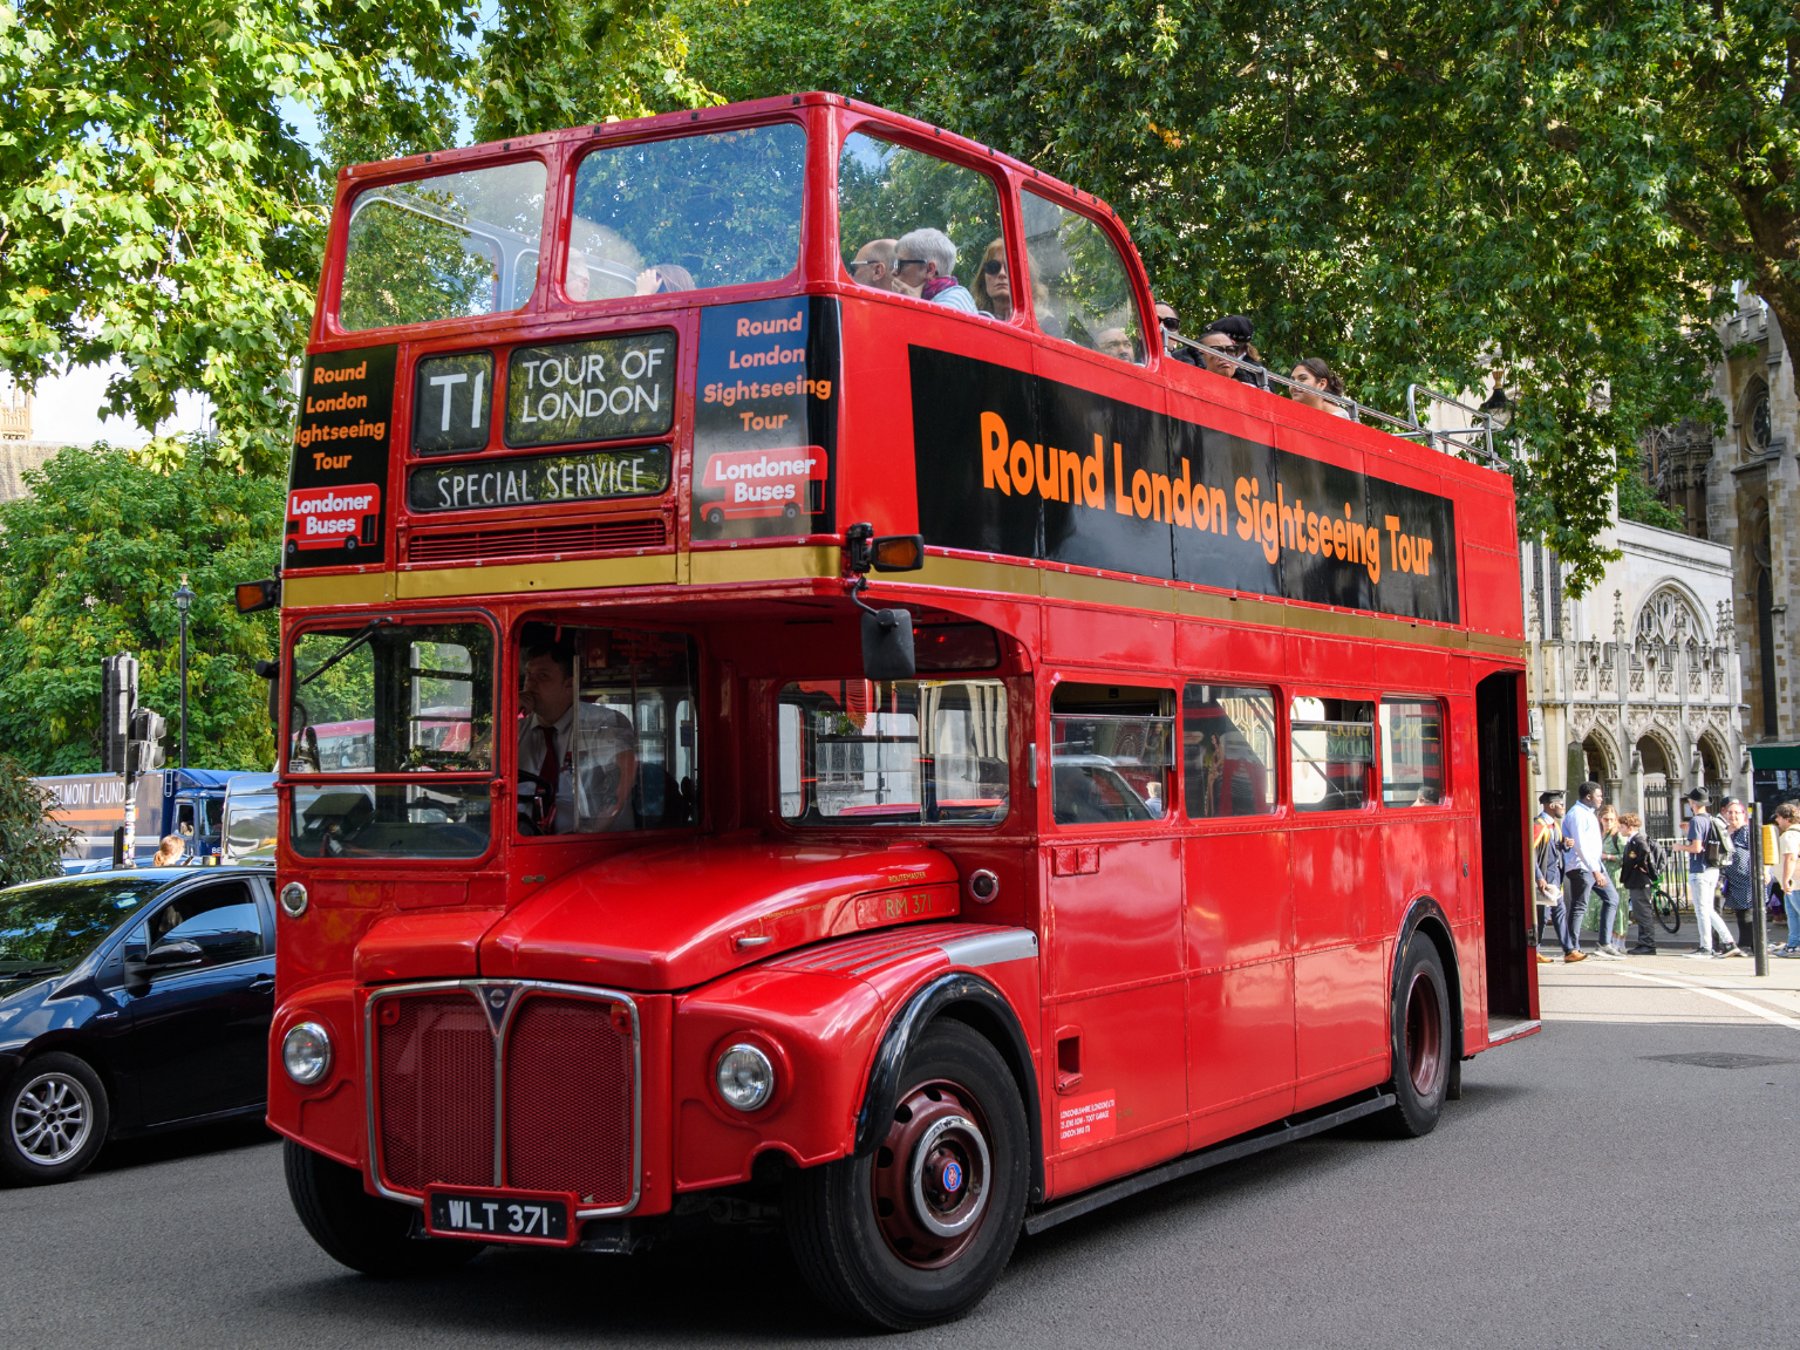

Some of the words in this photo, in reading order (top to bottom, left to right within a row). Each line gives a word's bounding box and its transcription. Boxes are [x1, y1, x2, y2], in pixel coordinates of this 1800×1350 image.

[736, 311, 803, 337] Round
[522, 354, 606, 390] TOUR
[621, 348, 665, 380] OF
[729, 345, 806, 370] London
[314, 361, 367, 385] Round
[306, 391, 368, 414] London
[430, 370, 485, 432] T1
[704, 375, 832, 407] Sightseeing
[522, 384, 660, 424] LONDON
[294, 419, 386, 448] ightseeing
[739, 412, 788, 431] Tour
[313, 452, 353, 471] Tour
[715, 456, 816, 481] Londoner
[438, 469, 535, 508] SPECIAL
[546, 458, 646, 499] SERVICE
[734, 482, 796, 503] Buses
[292, 492, 373, 515] Londoner
[980, 411, 1105, 510] Round
[1113, 443, 1228, 536] London
[1235, 476, 1381, 585] Sightseeing
[1385, 514, 1434, 577] Tour
[306, 516, 356, 535] Buses
[93, 781, 140, 804] LAUNDY
[888, 871, 927, 882] ROUTEMASTER
[885, 896, 908, 918] RM
[912, 894, 932, 914] 371
[448, 1199, 499, 1231] WLT
[507, 1204, 549, 1235] 371
